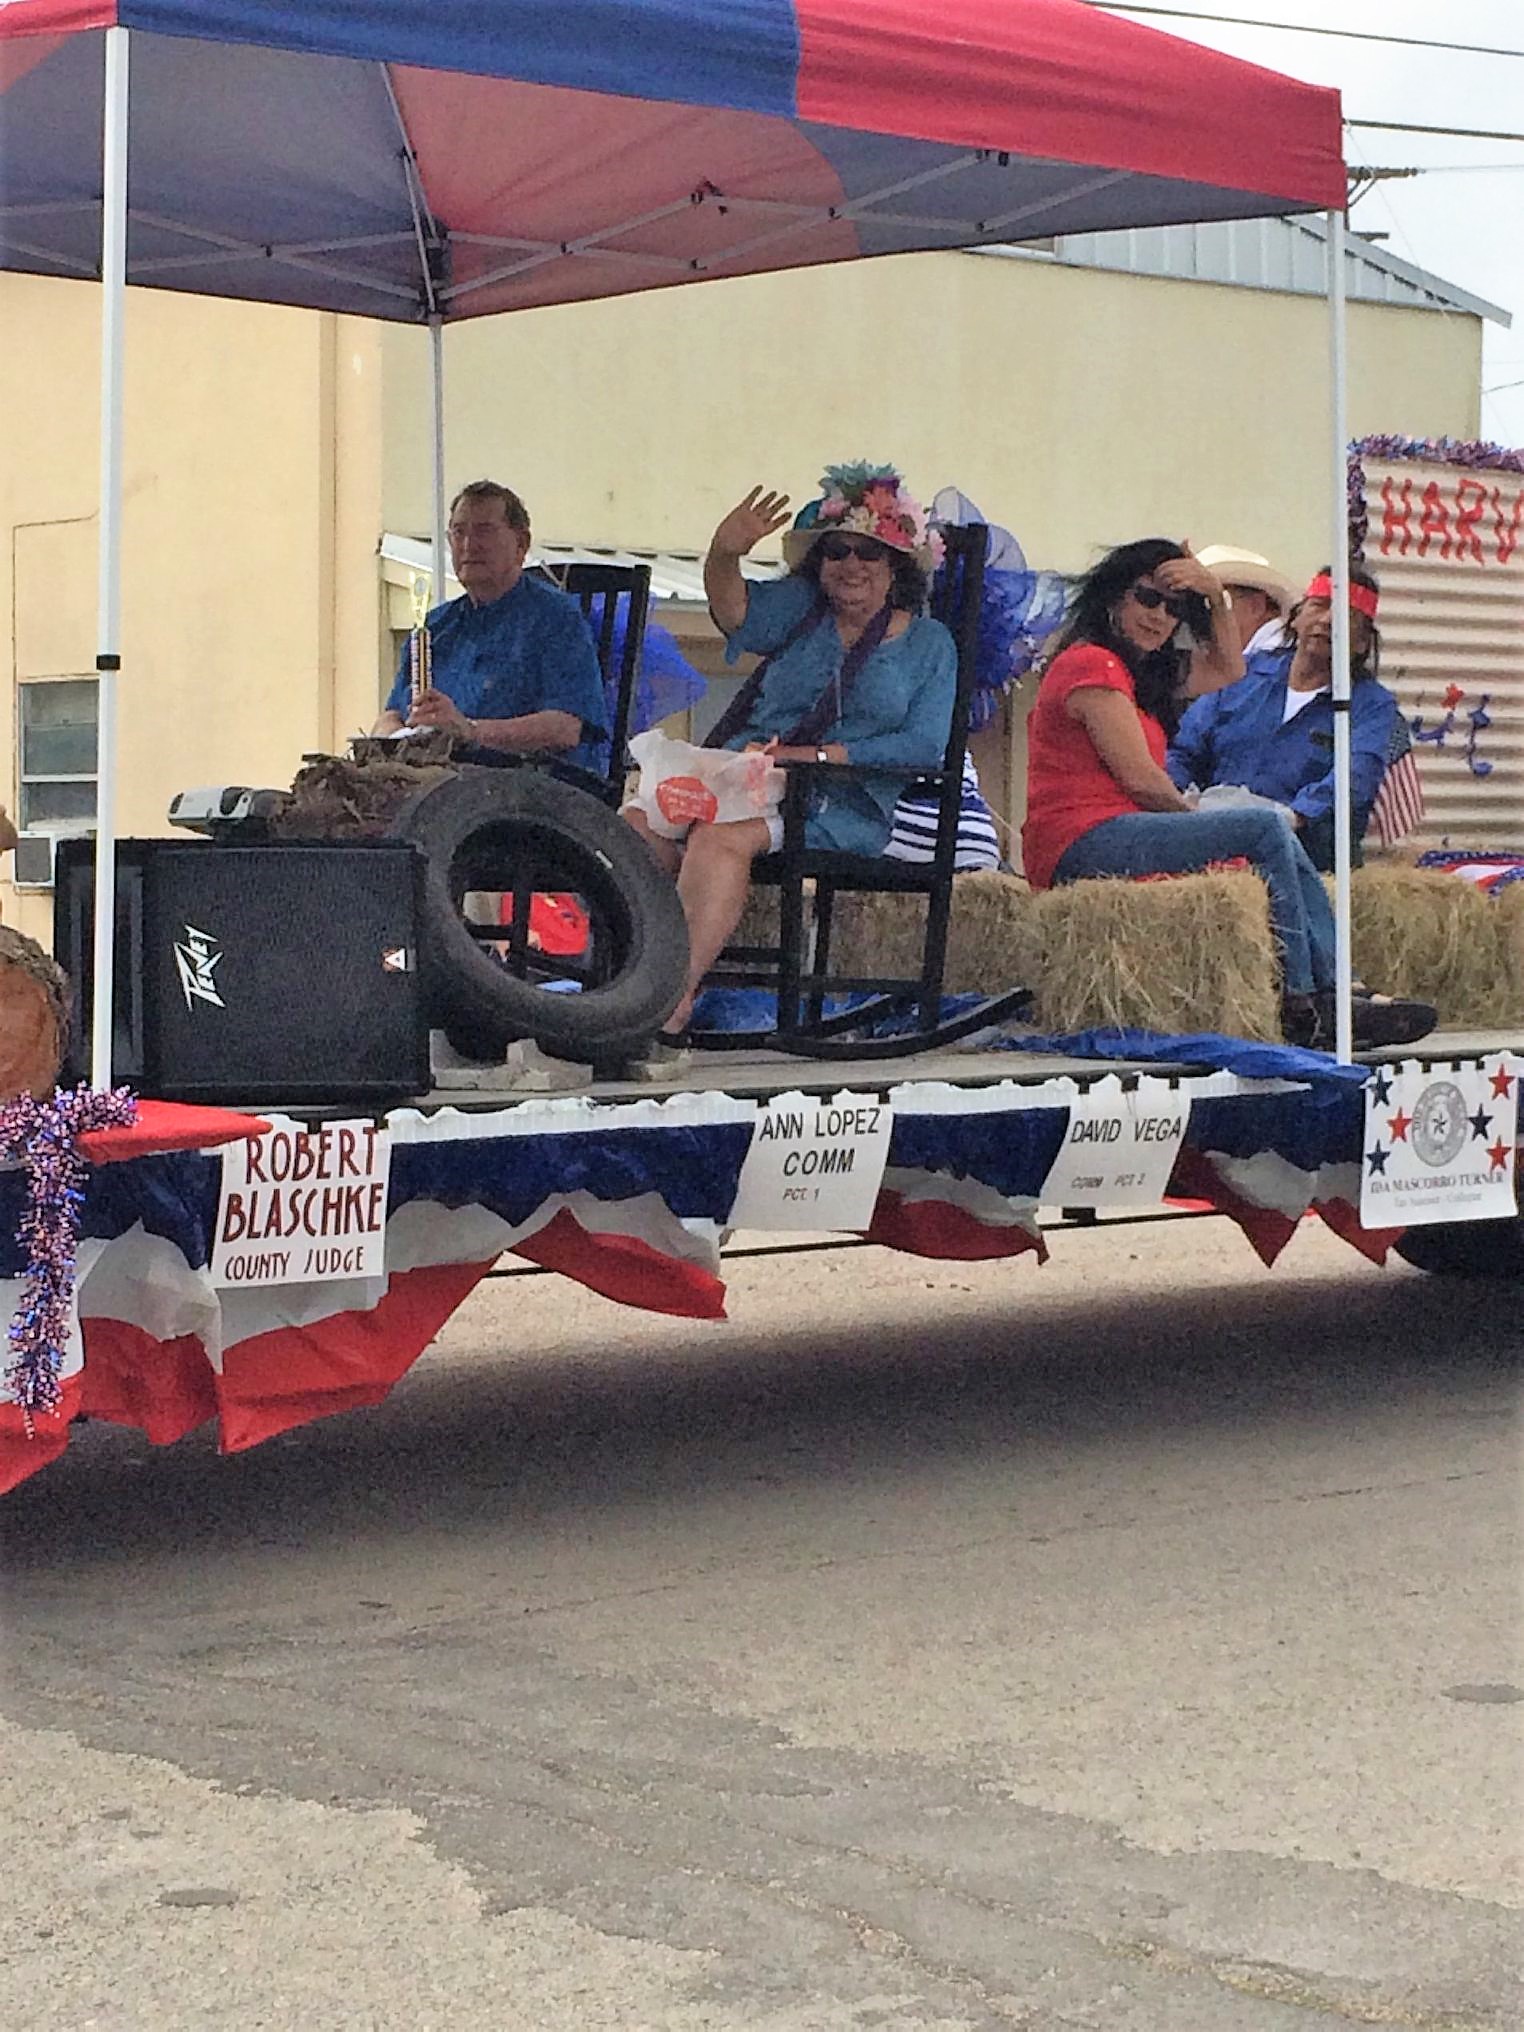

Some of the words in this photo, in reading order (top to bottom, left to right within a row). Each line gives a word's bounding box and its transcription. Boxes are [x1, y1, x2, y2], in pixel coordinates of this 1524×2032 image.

[759, 1112, 803, 1141] ANN
[815, 1107, 880, 1137] LOPEZ
[1070, 1118, 1121, 1143] DAVID
[1135, 1116, 1181, 1142] VEGA
[246, 1126, 378, 1185] ROBERT
[783, 1148, 855, 1176] COMM
[782, 1187, 808, 1201] PCT
[814, 1188, 820, 1202] 1
[1459, 1171, 1504, 1187] TURNER
[222, 1183, 384, 1243] BLASCHKE
[225, 1252, 291, 1280] COUNTY
[304, 1246, 364, 1274] JUDGE
